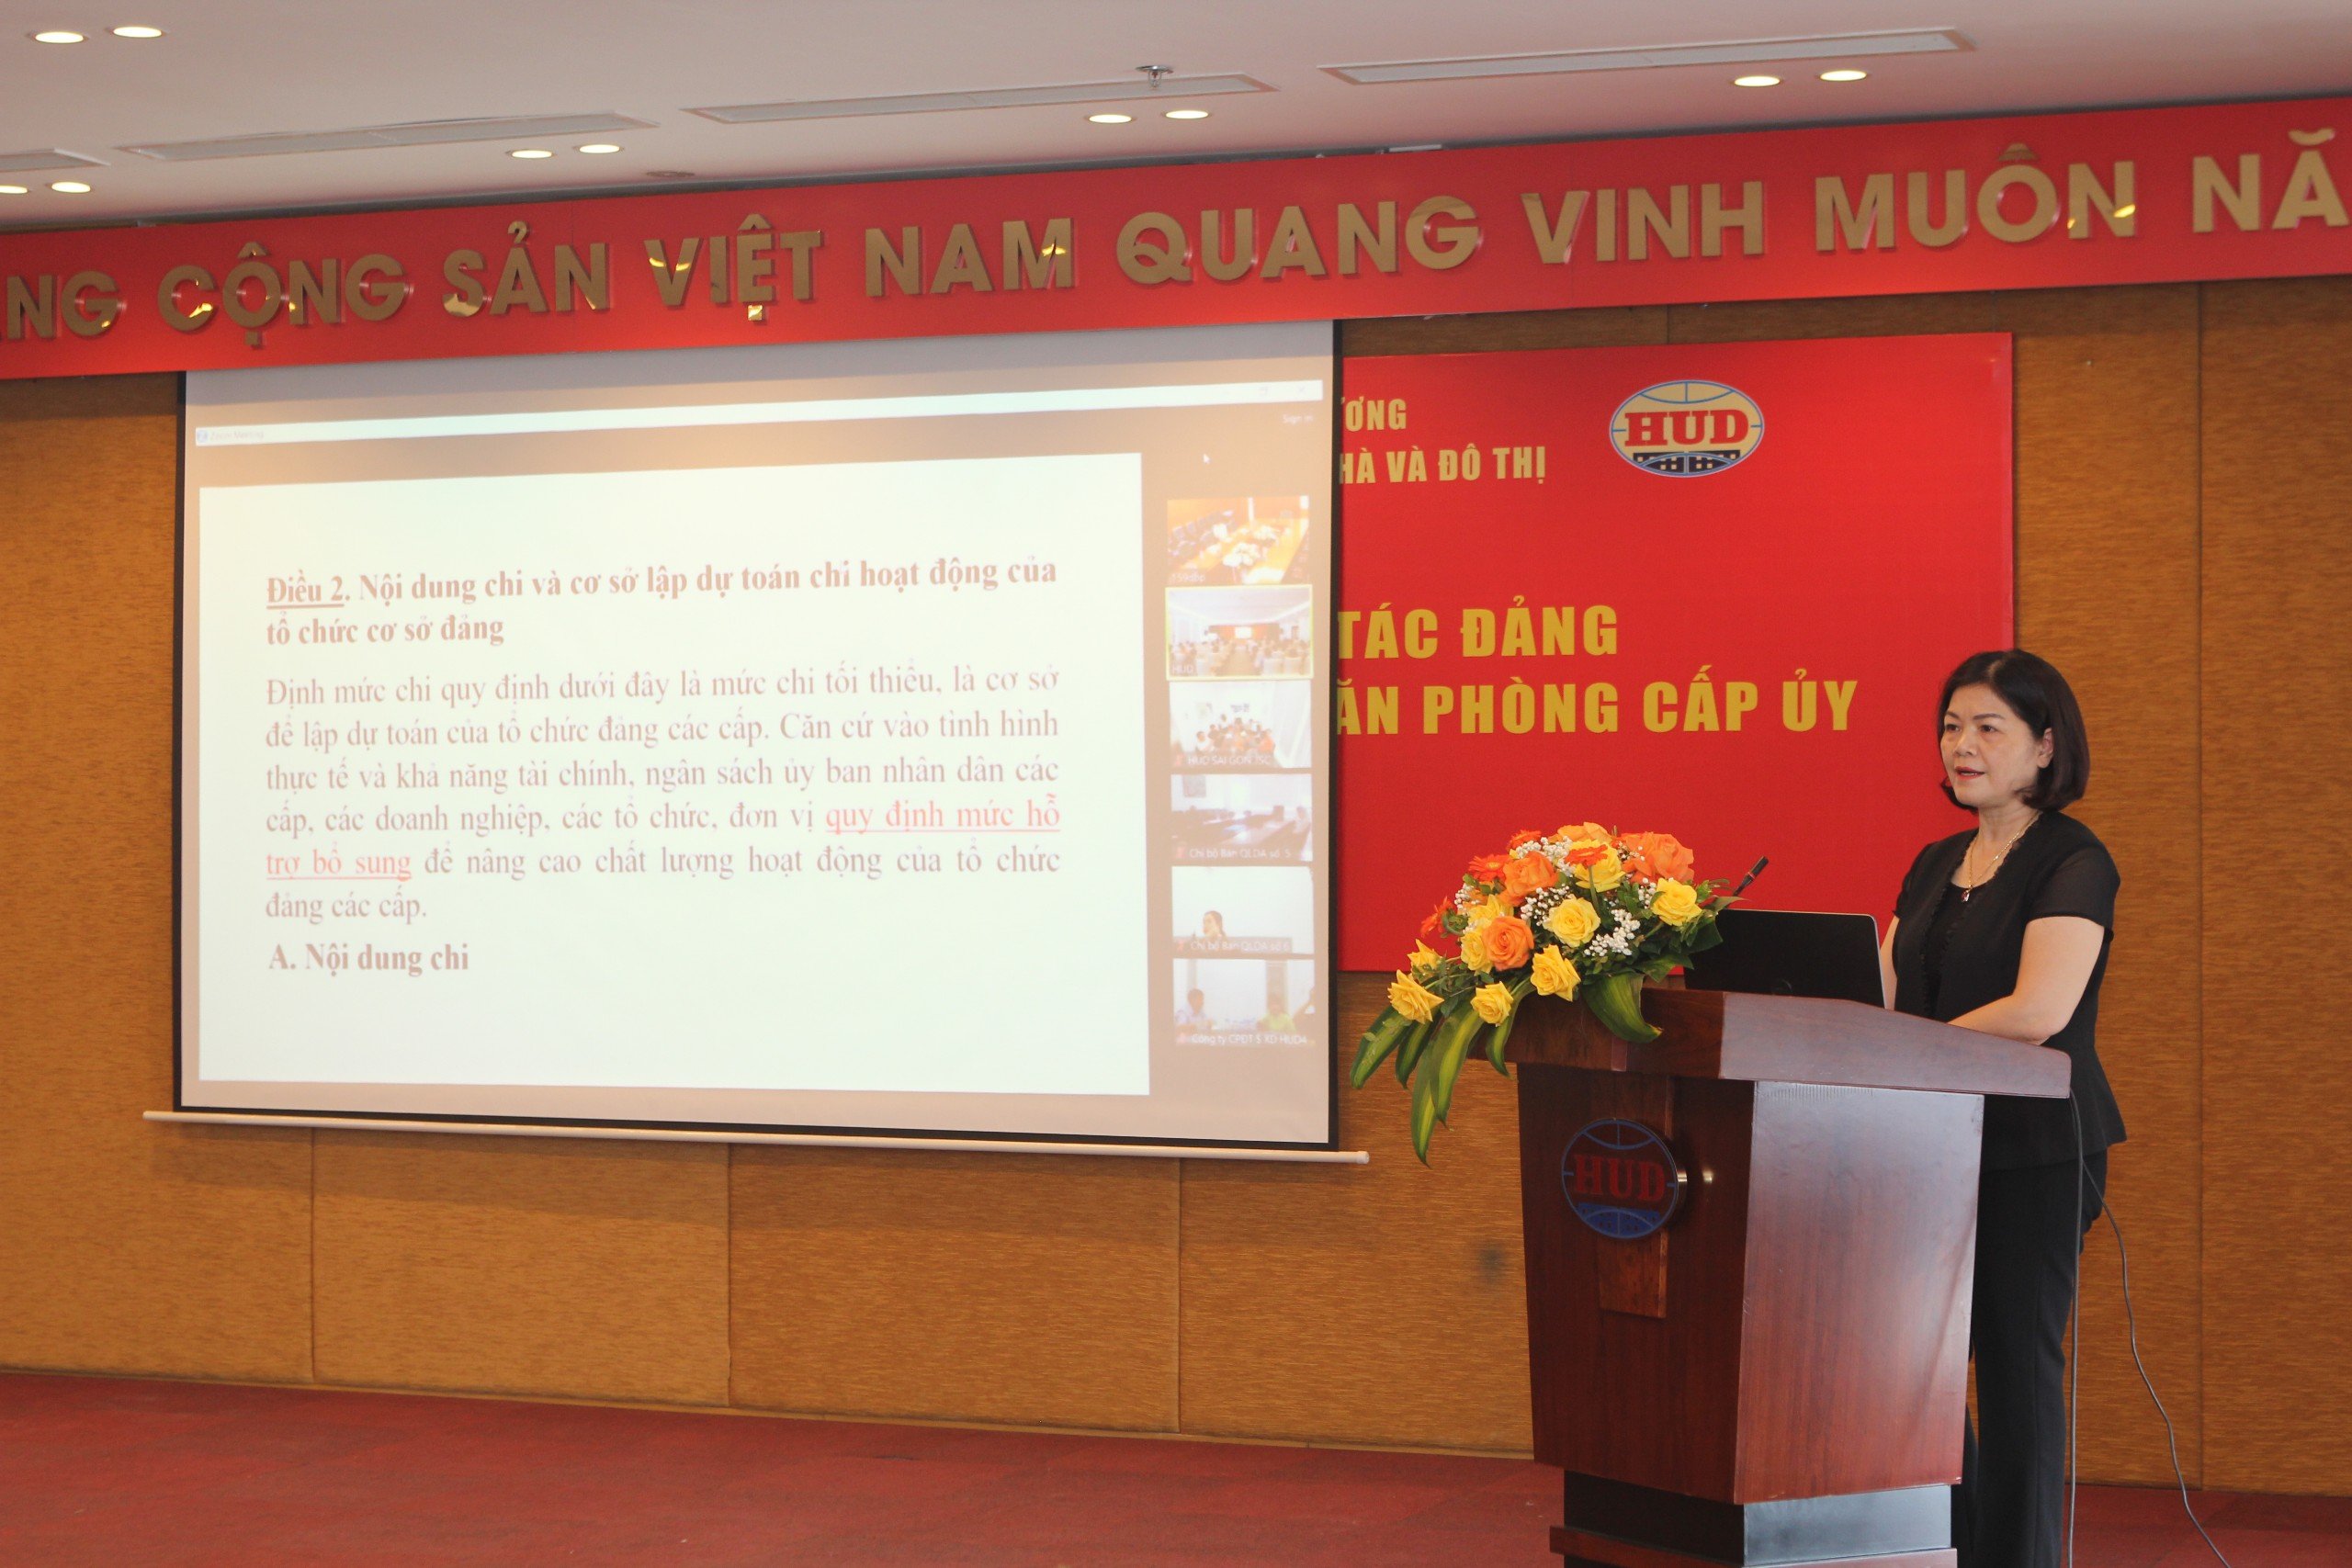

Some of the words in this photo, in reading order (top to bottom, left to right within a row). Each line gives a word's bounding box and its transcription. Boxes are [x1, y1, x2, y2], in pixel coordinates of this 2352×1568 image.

[157, 242, 408, 346] CỘNG
[443, 220, 608, 318] SẢN
[645, 213, 821, 322] VIỆT
[865, 218, 1073, 298] NAM
[1116, 195, 1479, 286] QUANG
[1521, 182, 1765, 265] VINH
[1815, 143, 2136, 253] MUÔN
[1341, 396, 1408, 432] ƠNG
[1624, 409, 1749, 446] HUD
[1386, 445, 1427, 482] VÀ
[1438, 443, 1481, 481] ĐÔ
[1493, 446, 1546, 484] THỊ
[266, 569, 325, 605] Điều
[328, 575, 355, 604] 2.
[358, 572, 402, 607] Nội
[412, 572, 478, 606] dung
[484, 570, 526, 601] chi
[530, 570, 562, 597] và
[570, 573, 603, 595] cơ
[609, 567, 639, 594] sở
[647, 564, 689, 601] lập
[695, 564, 734, 599] dự
[741, 563, 800, 591] toán
[809, 558, 850, 589] chi
[860, 558, 921, 595] hoạt
[926, 557, 1000, 592] động
[1007, 556, 1057, 585] của
[266, 609, 294, 646] tổ
[298, 616, 360, 647] chức
[367, 623, 398, 645] cơ
[404, 615, 434, 641] sở
[440, 614, 507, 647] đảng
[1338, 603, 1438, 660] TÁC
[1460, 595, 1617, 658] ĐẢNG
[266, 678, 324, 710] Định
[334, 677, 388, 704] mức
[396, 675, 431, 703] chi
[441, 682, 487, 708] quy
[493, 673, 549, 705] định
[559, 671, 616, 700] dưới
[625, 671, 669, 705] đây
[681, 670, 701, 696] là
[712, 669, 766, 696] mức
[776, 667, 814, 695] chi
[825, 660, 858, 694] tối
[869, 657, 942, 694] thiểu,
[955, 665, 976, 692] là
[986, 672, 1018, 692] cơ
[1028, 665, 1059, 691] sở
[1337, 678, 1398, 735] ĂN
[1423, 676, 1618, 734] PHÒNG
[1644, 664, 1758, 732] CẤP
[1782, 669, 1858, 731] ỦY
[265, 715, 294, 748] để
[304, 721, 338, 754] lập
[347, 720, 379, 751] dự
[386, 718, 437, 748] toán
[447, 719, 489, 745] của
[498, 710, 521, 744] tổ
[530, 716, 589, 744] chức
[598, 716, 662, 750] đảng
[668, 714, 708, 742] các
[718, 706, 769, 748] cấp.
[780, 713, 831, 739] Căn
[842, 712, 874, 739] cứ
[883, 714, 930, 738] vào
[939, 709, 989, 737] tình
[1001, 709, 1058, 737] hình
[266, 764, 318, 795] thực
[328, 756, 349, 789] tế
[359, 762, 387, 788] và
[397, 762, 439, 788] khả
[449, 763, 508, 795] năng
[517, 760, 548, 789] tài
[559, 759, 635, 788] chính,
[646, 759, 706, 794] ngân
[718, 757, 774, 785] sách
[785, 758, 814, 792] ủy
[826, 757, 871, 786] ban
[884, 756, 946, 783] nhân
[956, 755, 1004, 783] dân
[1015, 754, 1058, 783] các
[266, 799, 314, 840] cấp,
[324, 805, 364, 832] các
[375, 804, 449, 831] doanh
[460, 803, 550, 838] nghiệp,
[562, 802, 603, 830] các
[615, 796, 639, 829] tổ
[650, 801, 718, 829] chức,
[728, 802, 777, 828] đơn
[791, 801, 813, 832] vị
[825, 808, 876, 837] quy
[883, 799, 947, 833] định
[957, 799, 1014, 829] mức
[1027, 794, 1060, 829] hỗ
[266, 852, 303, 882] trợ
[312, 842, 344, 874] bổ
[353, 854, 413, 883] sung
[424, 841, 454, 875] để
[467, 847, 526, 882] nâng
[539, 855, 582, 874] cao
[595, 840, 647, 874] chất
[662, 846, 735, 882] lượng
[749, 845, 802, 877] hoạt
[817, 845, 882, 881] động
[897, 845, 942, 873] của
[956, 838, 982, 874] tổ
[996, 844, 1060, 874] chức
[266, 892, 323, 926] đảng
[331, 891, 370, 919] các
[379, 885, 426, 926] cấp.
[268, 943, 297, 970] A.
[305, 942, 349, 978] Nội
[356, 943, 424, 977] dung
[430, 942, 469, 971] chi
[1574, 1154, 1665, 1202] HUD
